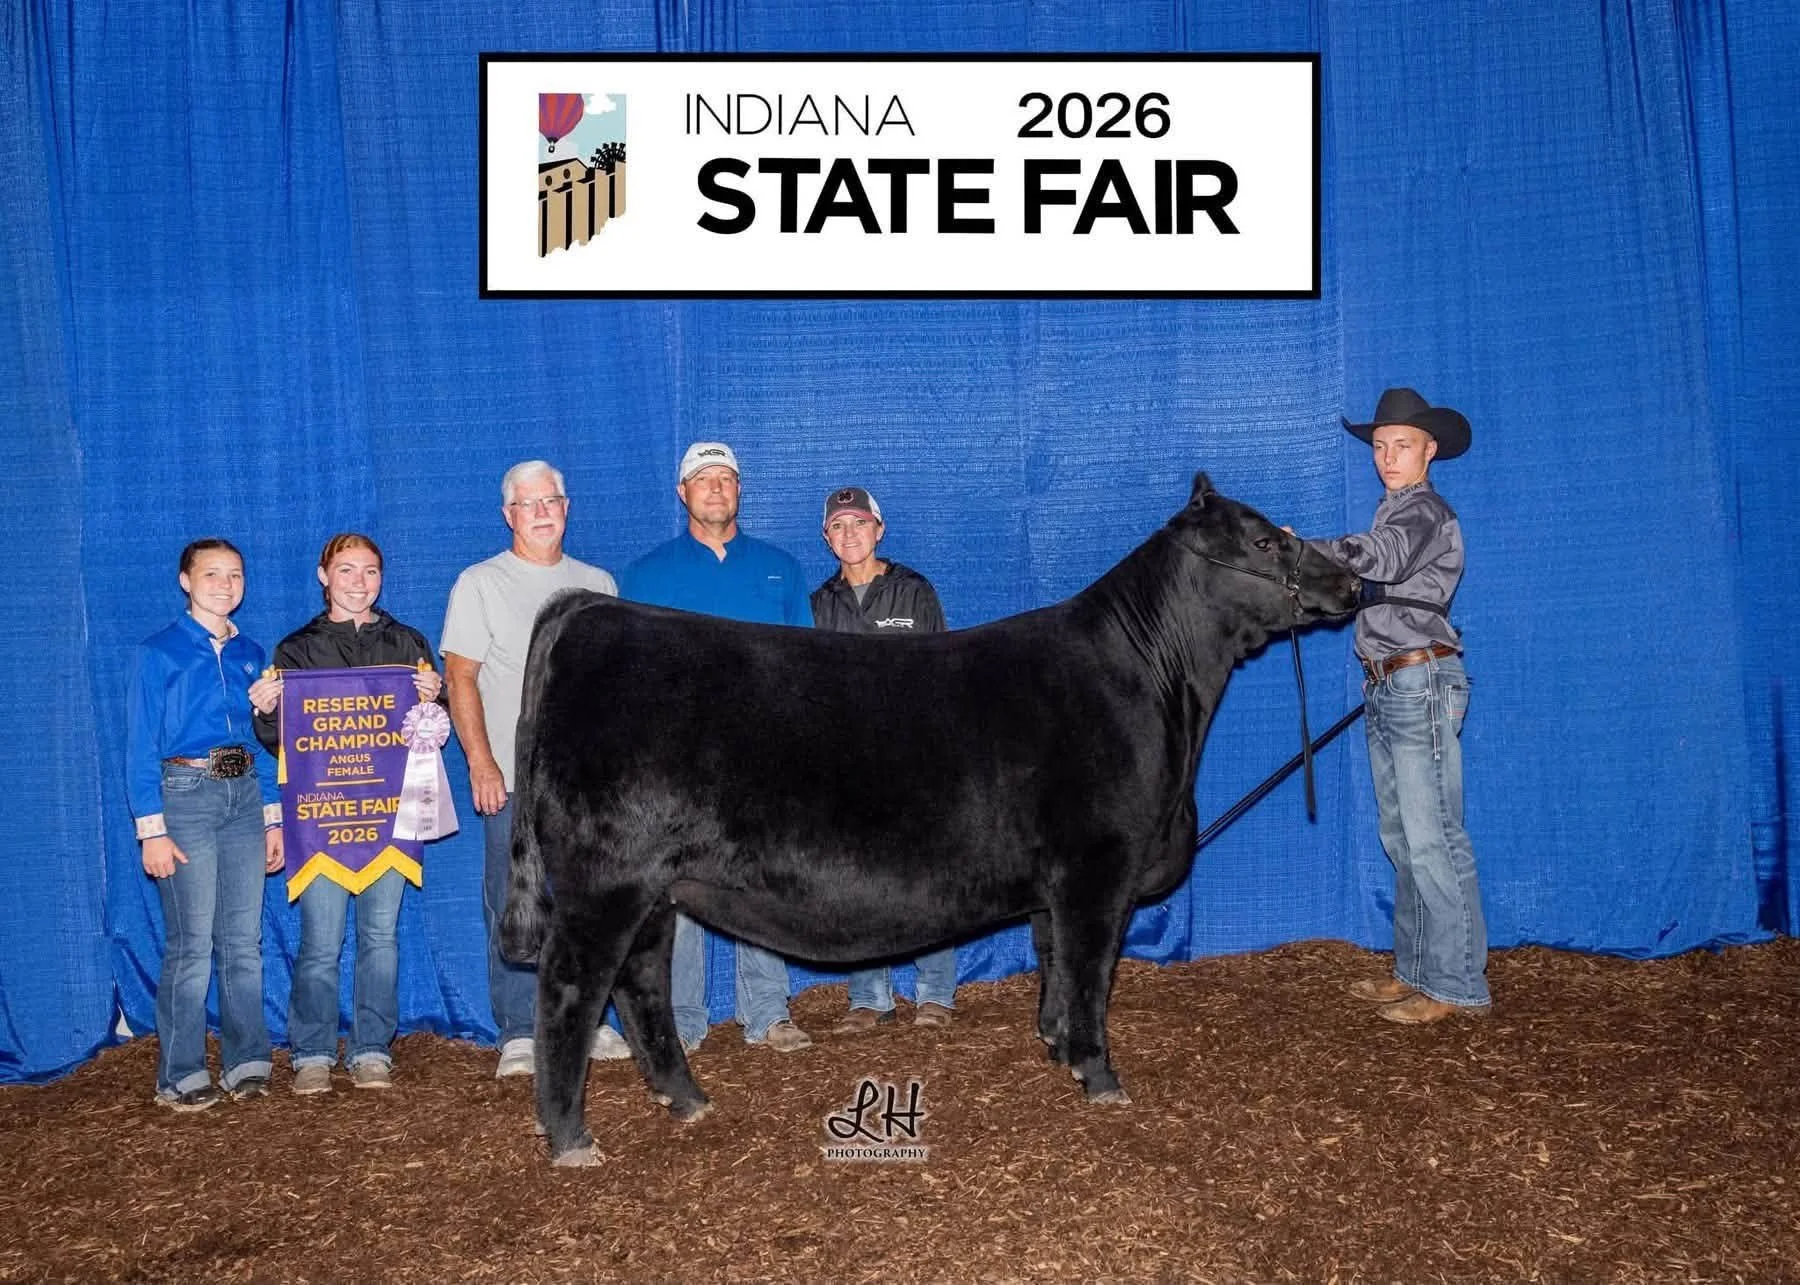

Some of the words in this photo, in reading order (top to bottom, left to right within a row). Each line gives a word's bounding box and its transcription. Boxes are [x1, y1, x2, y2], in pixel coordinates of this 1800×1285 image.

[303, 694, 396, 714] RESERVE
[313, 714, 388, 732] GRAND
[295, 731, 406, 752] CHAMPION
[329, 753, 371, 764] ANGUS
[327, 765, 375, 777] FEMALE
[297, 791, 345, 803] INDIANA
[297, 799, 358, 820] STATE
[327, 827, 379, 845] 2026
